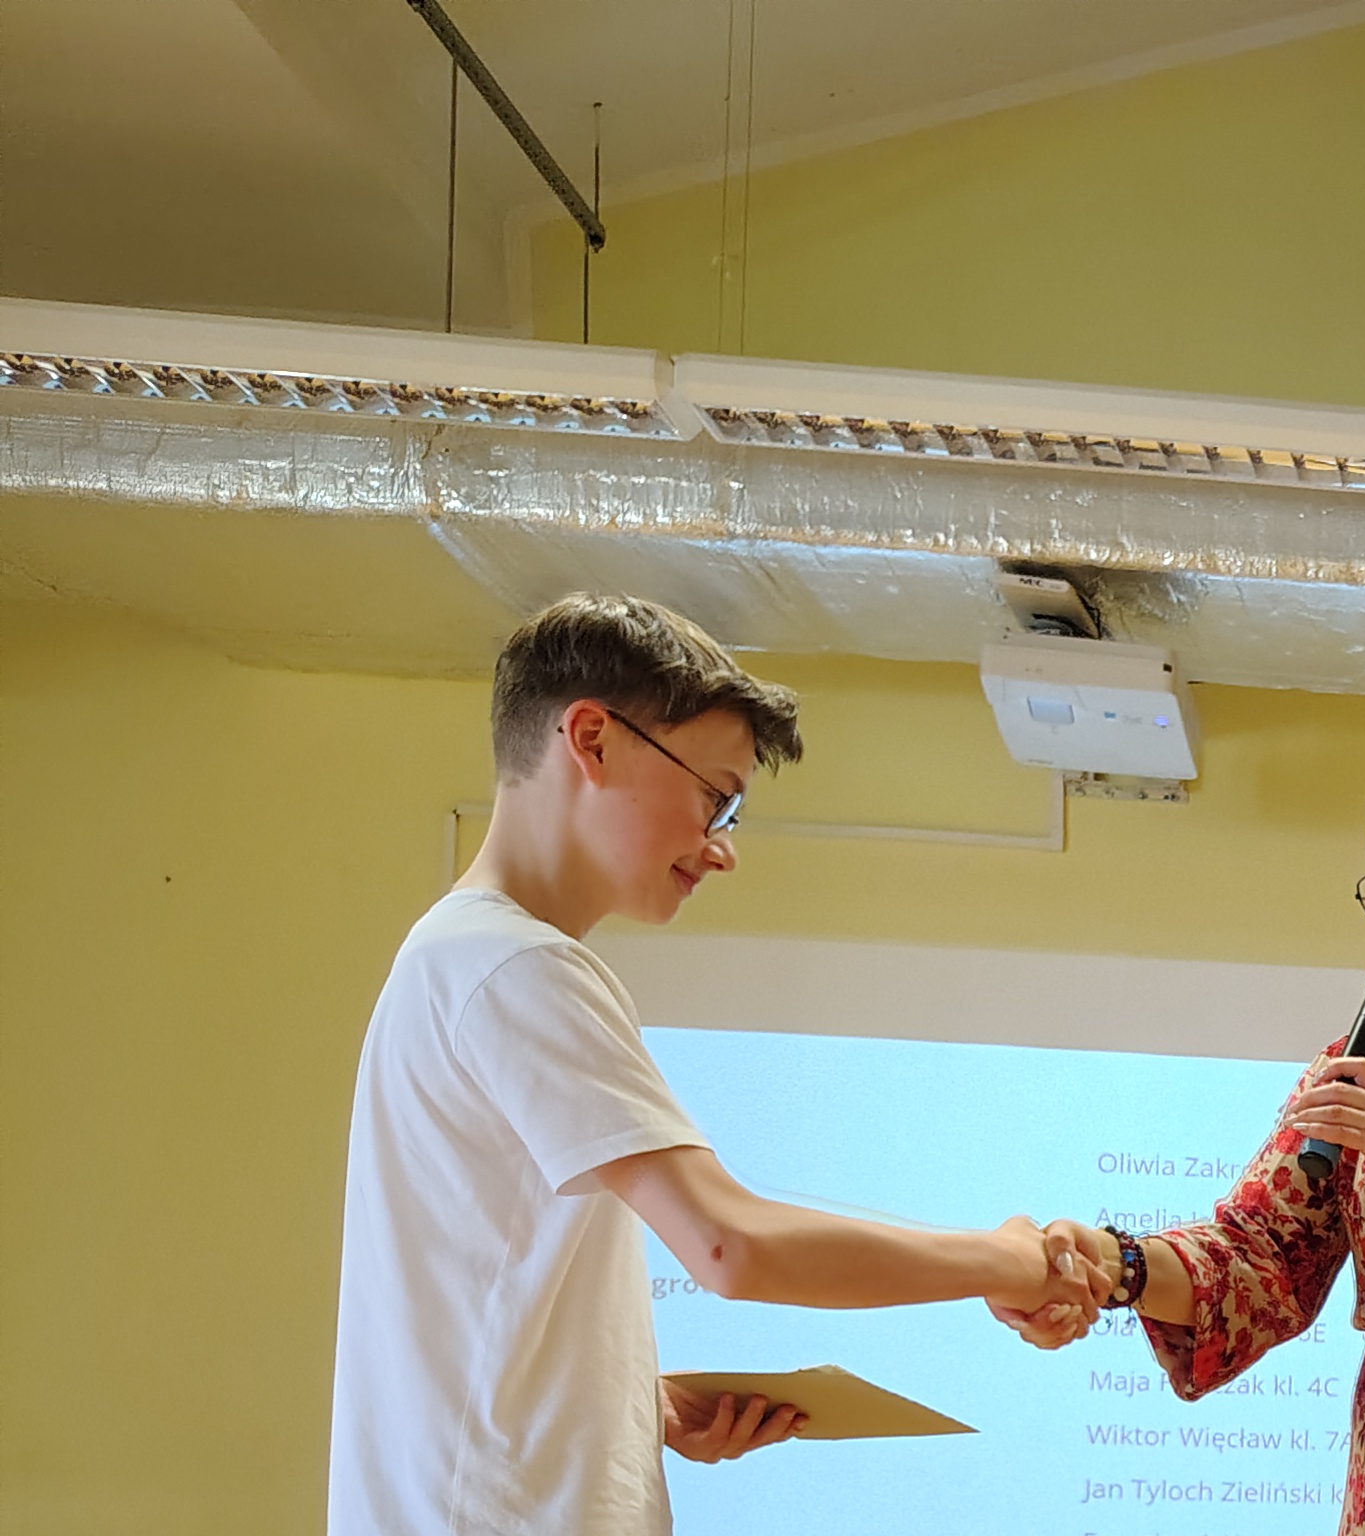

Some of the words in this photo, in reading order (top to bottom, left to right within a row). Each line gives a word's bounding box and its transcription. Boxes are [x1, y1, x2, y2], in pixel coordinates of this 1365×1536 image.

[1098, 1152, 1175, 1176] Oliwia
[1184, 1156, 1246, 1180] Zakr
[1095, 1207, 1182, 1229] Amelia
[1090, 1370, 1151, 1397] Maja
[1274, 1375, 1299, 1397] kl.
[1308, 1377, 1339, 1397] 4C
[1086, 1424, 1171, 1447] Wiktor
[1180, 1426, 1283, 1453] Więcław
[1291, 1429, 1316, 1451] kl.
[1326, 1431, 1351, 1452] 7A
[1081, 1479, 1124, 1503] Jan
[1132, 1479, 1214, 1505] Tyloch
[1222, 1480, 1322, 1505] Zieliński
